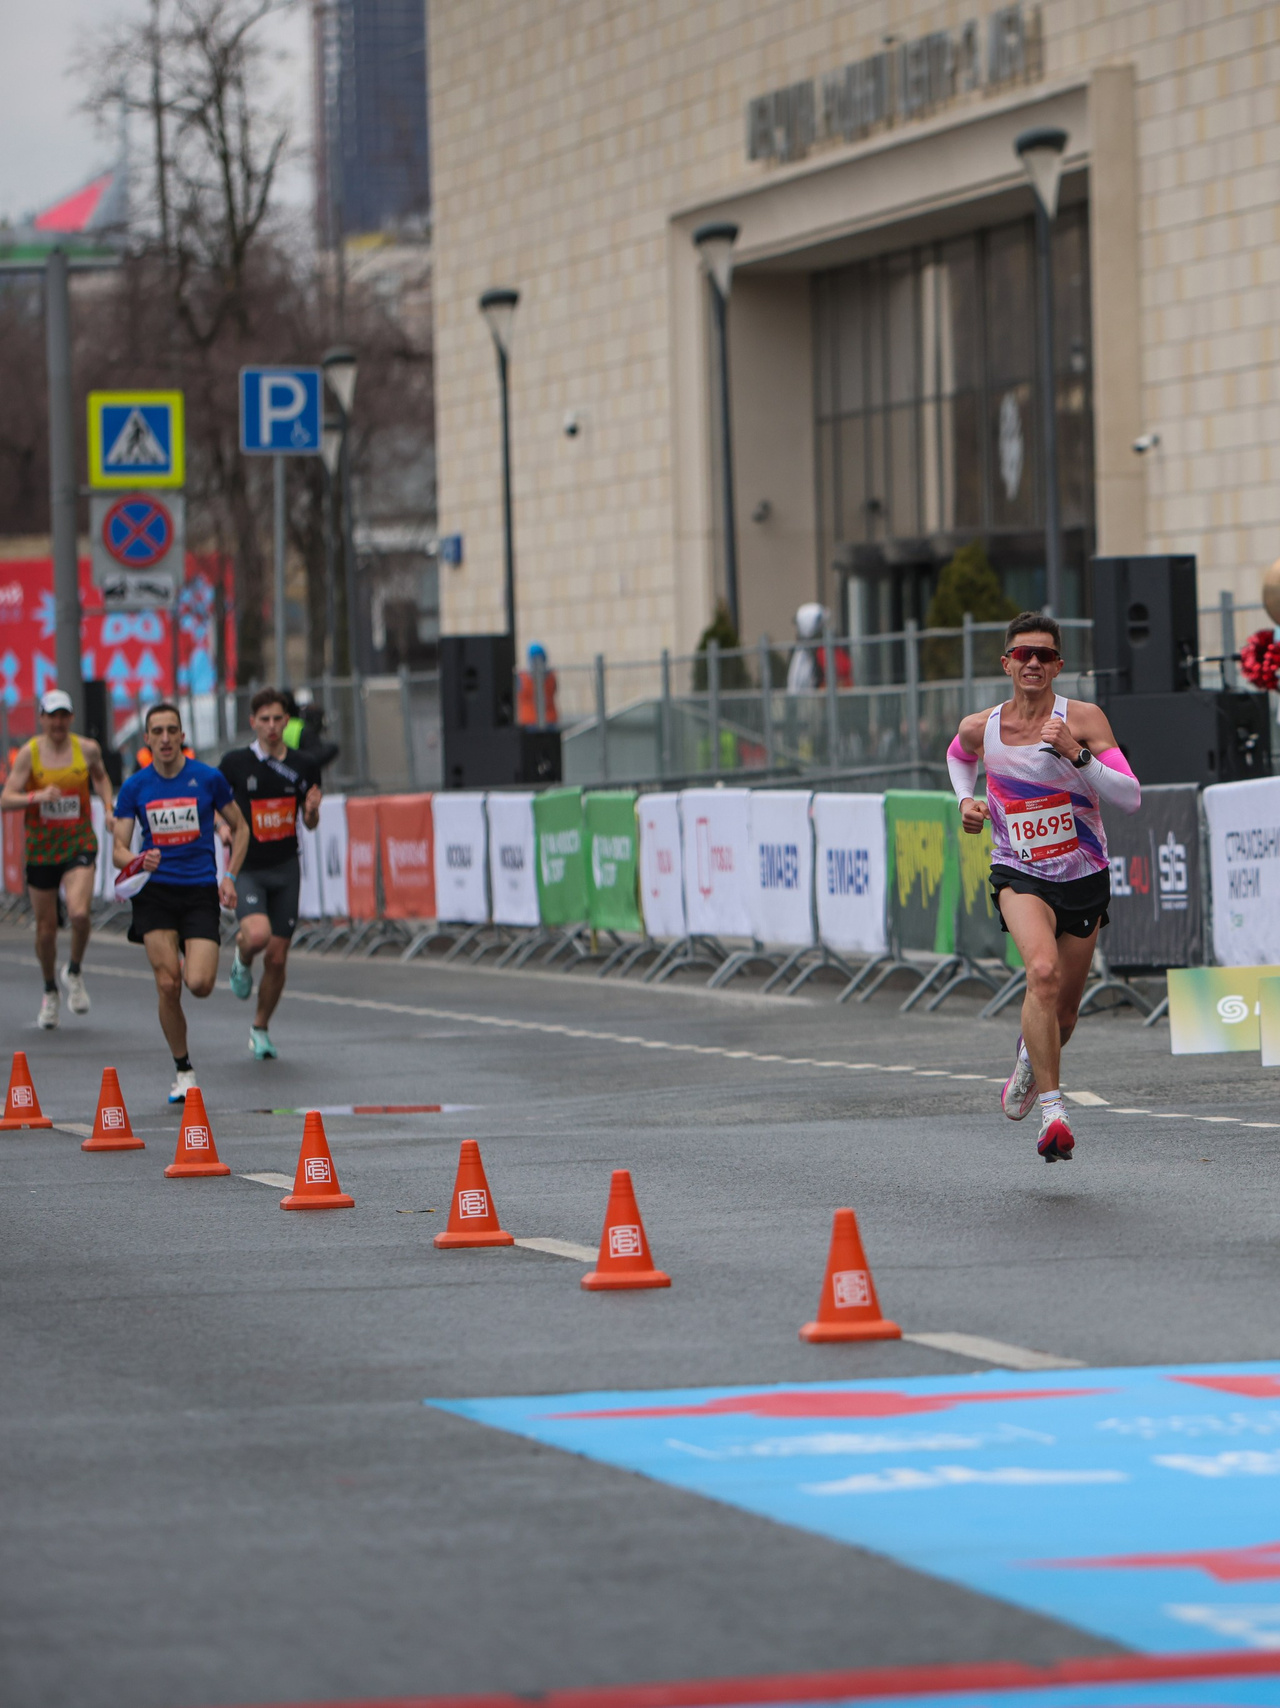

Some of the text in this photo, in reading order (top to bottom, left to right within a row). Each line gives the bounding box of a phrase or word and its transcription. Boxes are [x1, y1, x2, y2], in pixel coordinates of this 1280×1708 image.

[260, 375, 308, 445] P
[151, 809, 195, 826] 141-4
[1011, 811, 1073, 841] 18695
